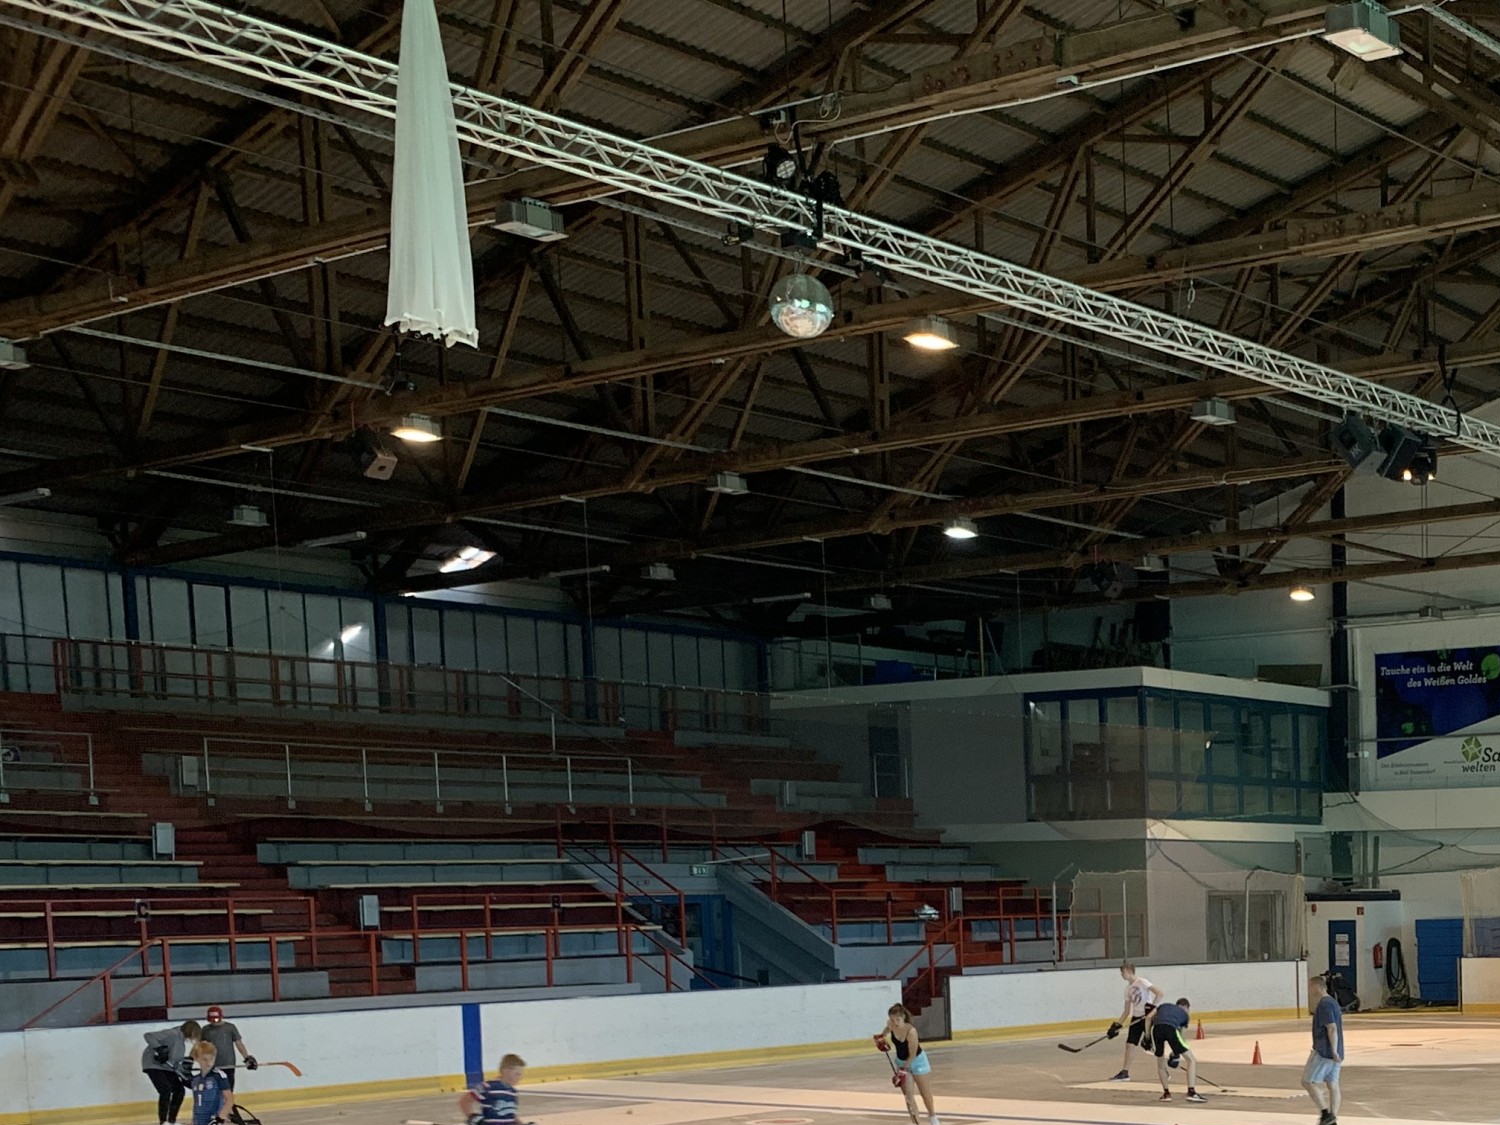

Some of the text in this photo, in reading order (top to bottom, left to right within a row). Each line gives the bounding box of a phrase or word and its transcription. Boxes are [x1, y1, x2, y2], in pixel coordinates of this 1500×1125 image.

[1380, 660, 1473, 676] Tauche ein in die Welt
[1407, 673, 1487, 688] des Weißen Goldes
[1462, 761, 1496, 773] welten
